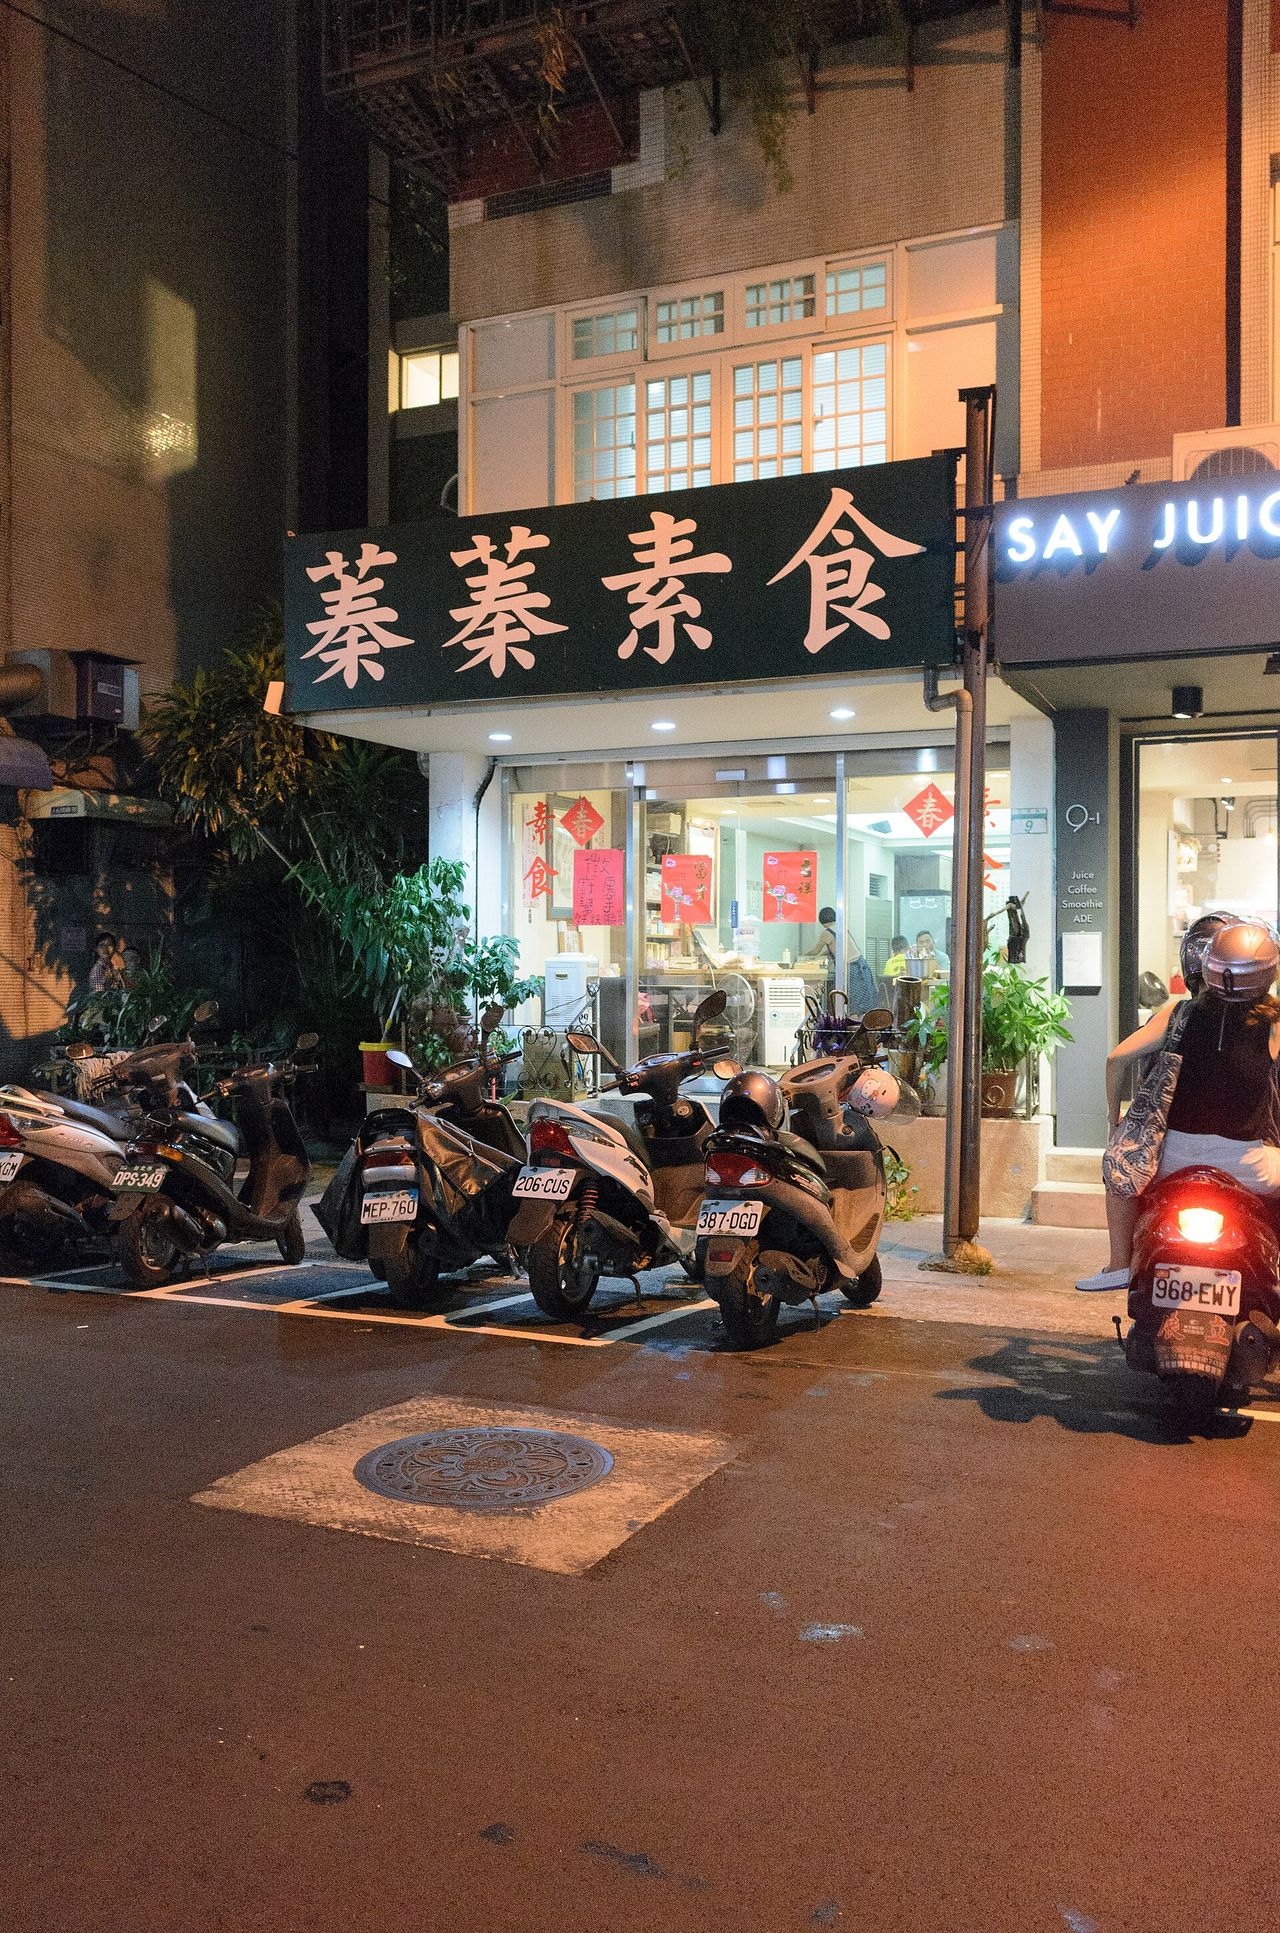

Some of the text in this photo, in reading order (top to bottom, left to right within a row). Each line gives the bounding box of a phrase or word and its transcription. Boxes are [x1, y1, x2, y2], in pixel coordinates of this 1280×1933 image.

[1007, 509, 1121, 562] SAY
[299, 487, 927, 690] 蓁蓁素食
[915, 791, 944, 830] 春
[1025, 819, 1034, 832] 9
[523, 801, 559, 899] 素食
[1071, 870, 1095, 880] Juice
[1067, 885, 1098, 894] Coffee
[1062, 900, 1103, 909] Smoothie
[1072, 914, 1093, 923] ADE
